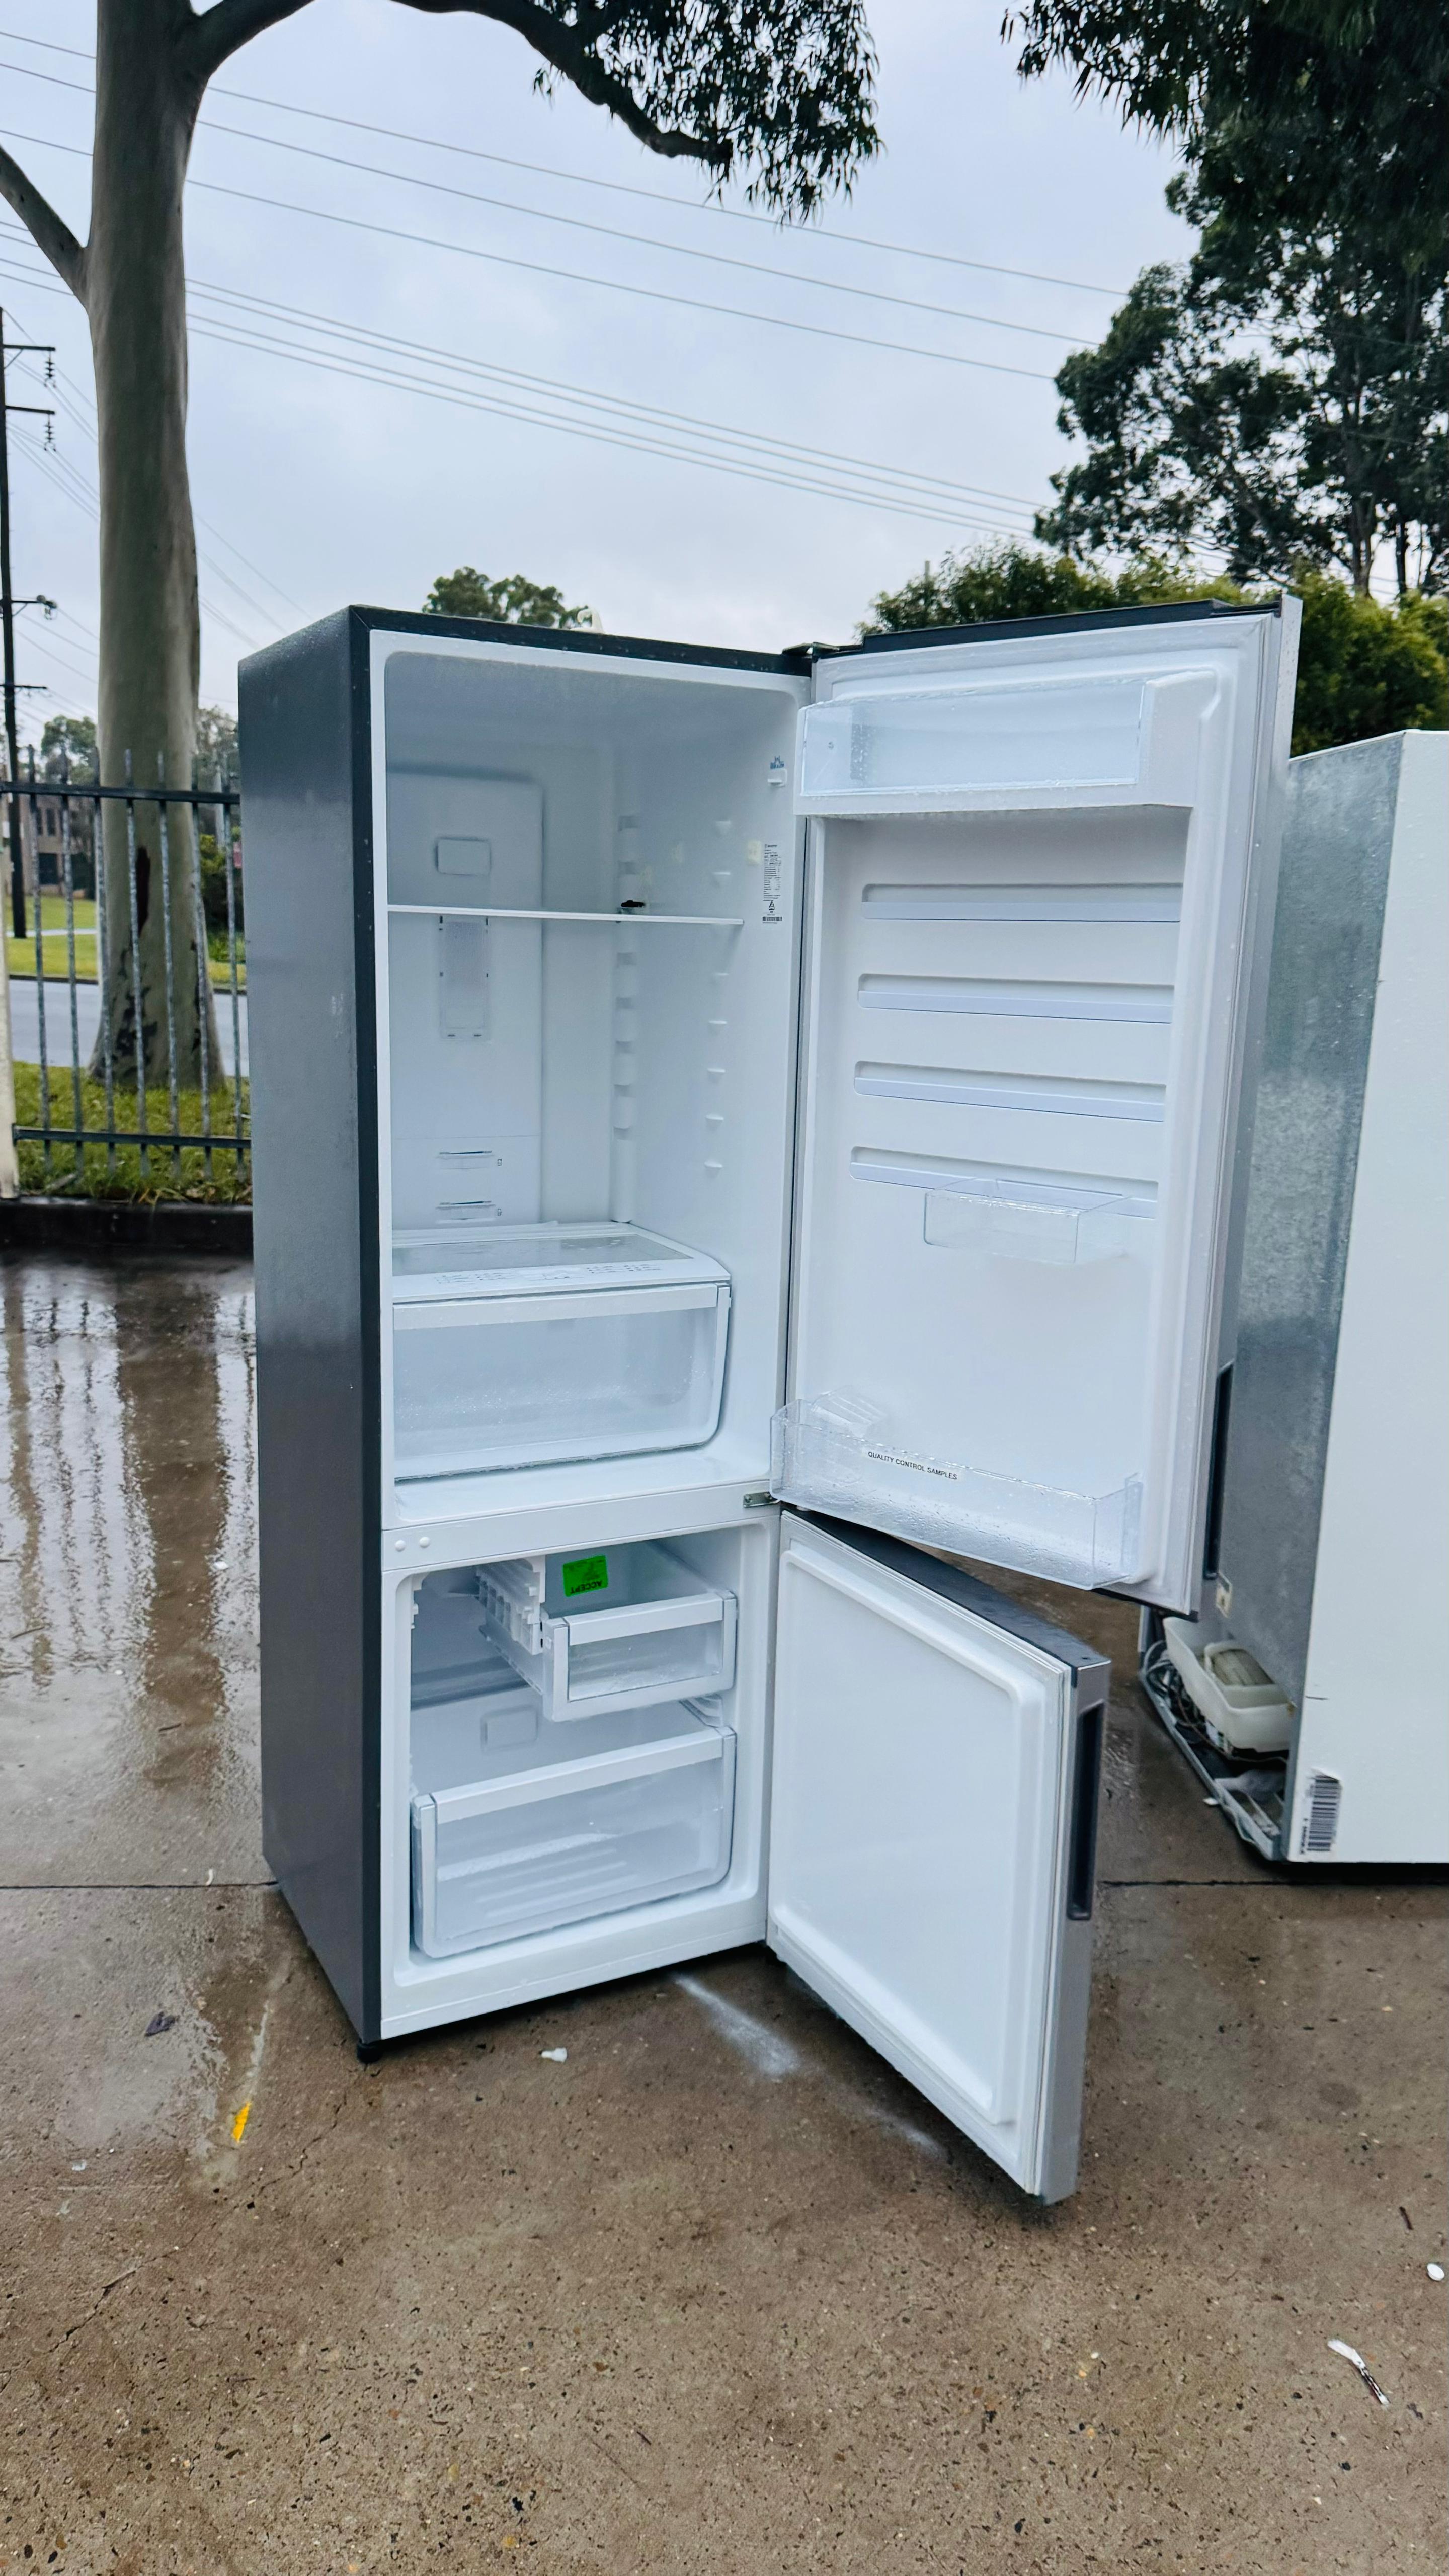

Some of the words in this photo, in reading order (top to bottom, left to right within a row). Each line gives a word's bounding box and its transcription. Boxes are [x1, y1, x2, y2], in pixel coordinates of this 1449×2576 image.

[868, 1451, 894, 1462] QUALITY
[895, 1459, 925, 1472] CONTROL
[927, 1467, 957, 1480] SAMPLES
[570, 1580, 602, 1594] ACCEPT
